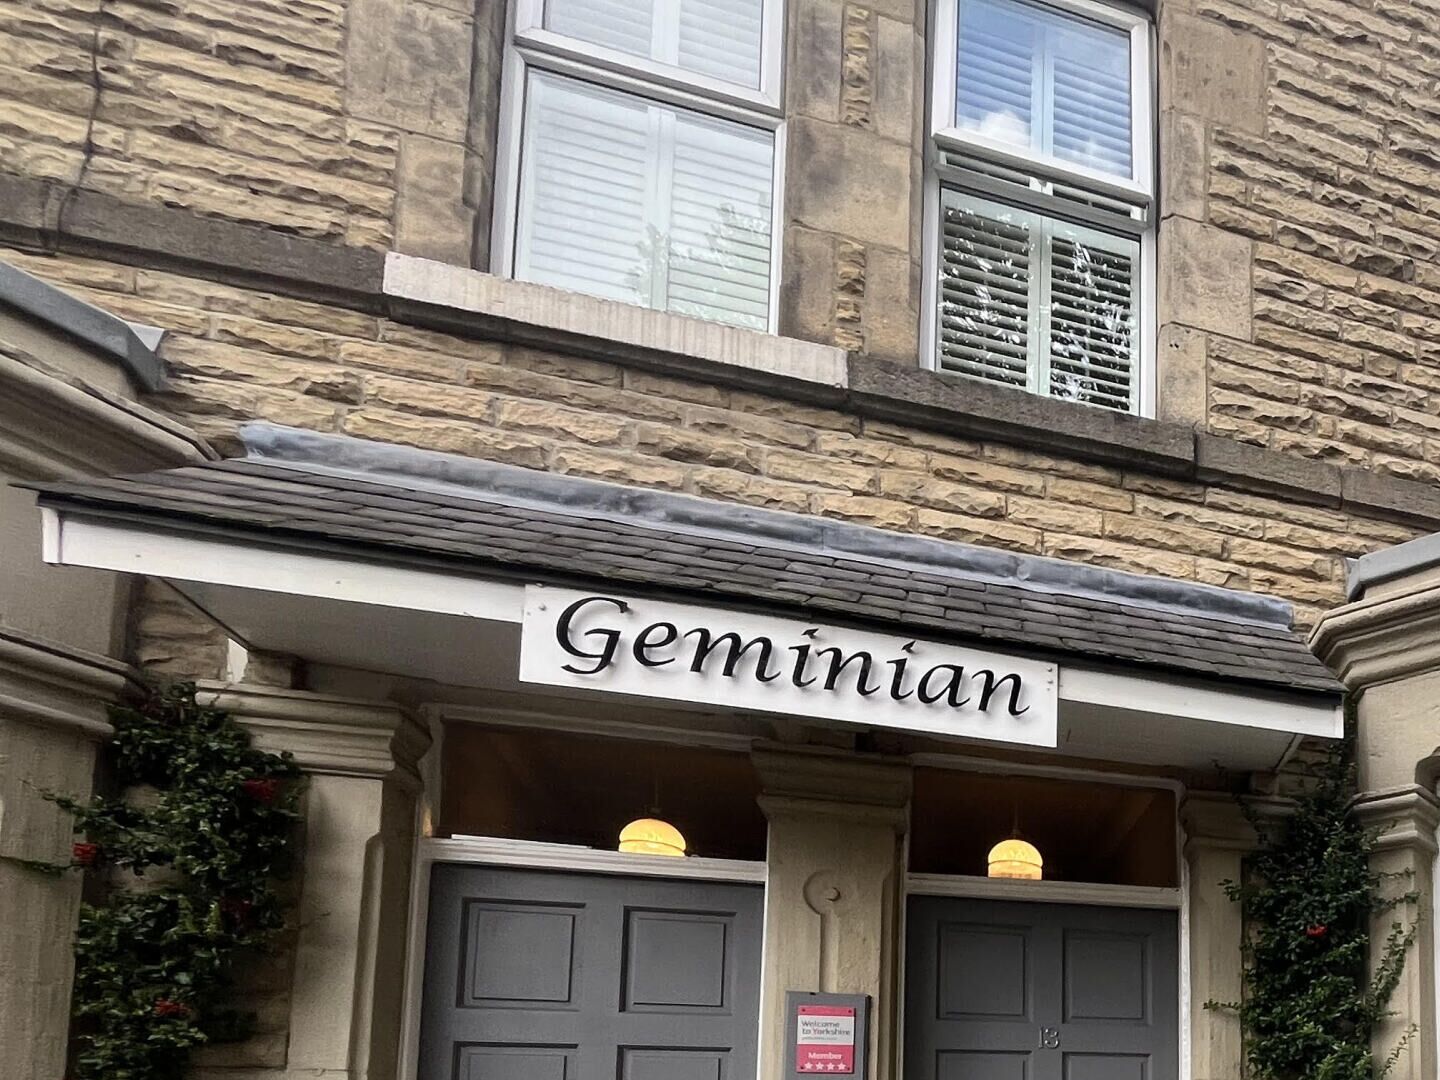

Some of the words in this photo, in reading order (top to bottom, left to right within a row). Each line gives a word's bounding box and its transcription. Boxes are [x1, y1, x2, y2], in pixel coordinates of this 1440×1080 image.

[556, 596, 1030, 716] Geminian
[801, 1020, 840, 1028] Welcome
[813, 1028, 850, 1036] Yorkshire
[1038, 1027, 1060, 1049] 13
[808, 1052, 842, 1060] Member
